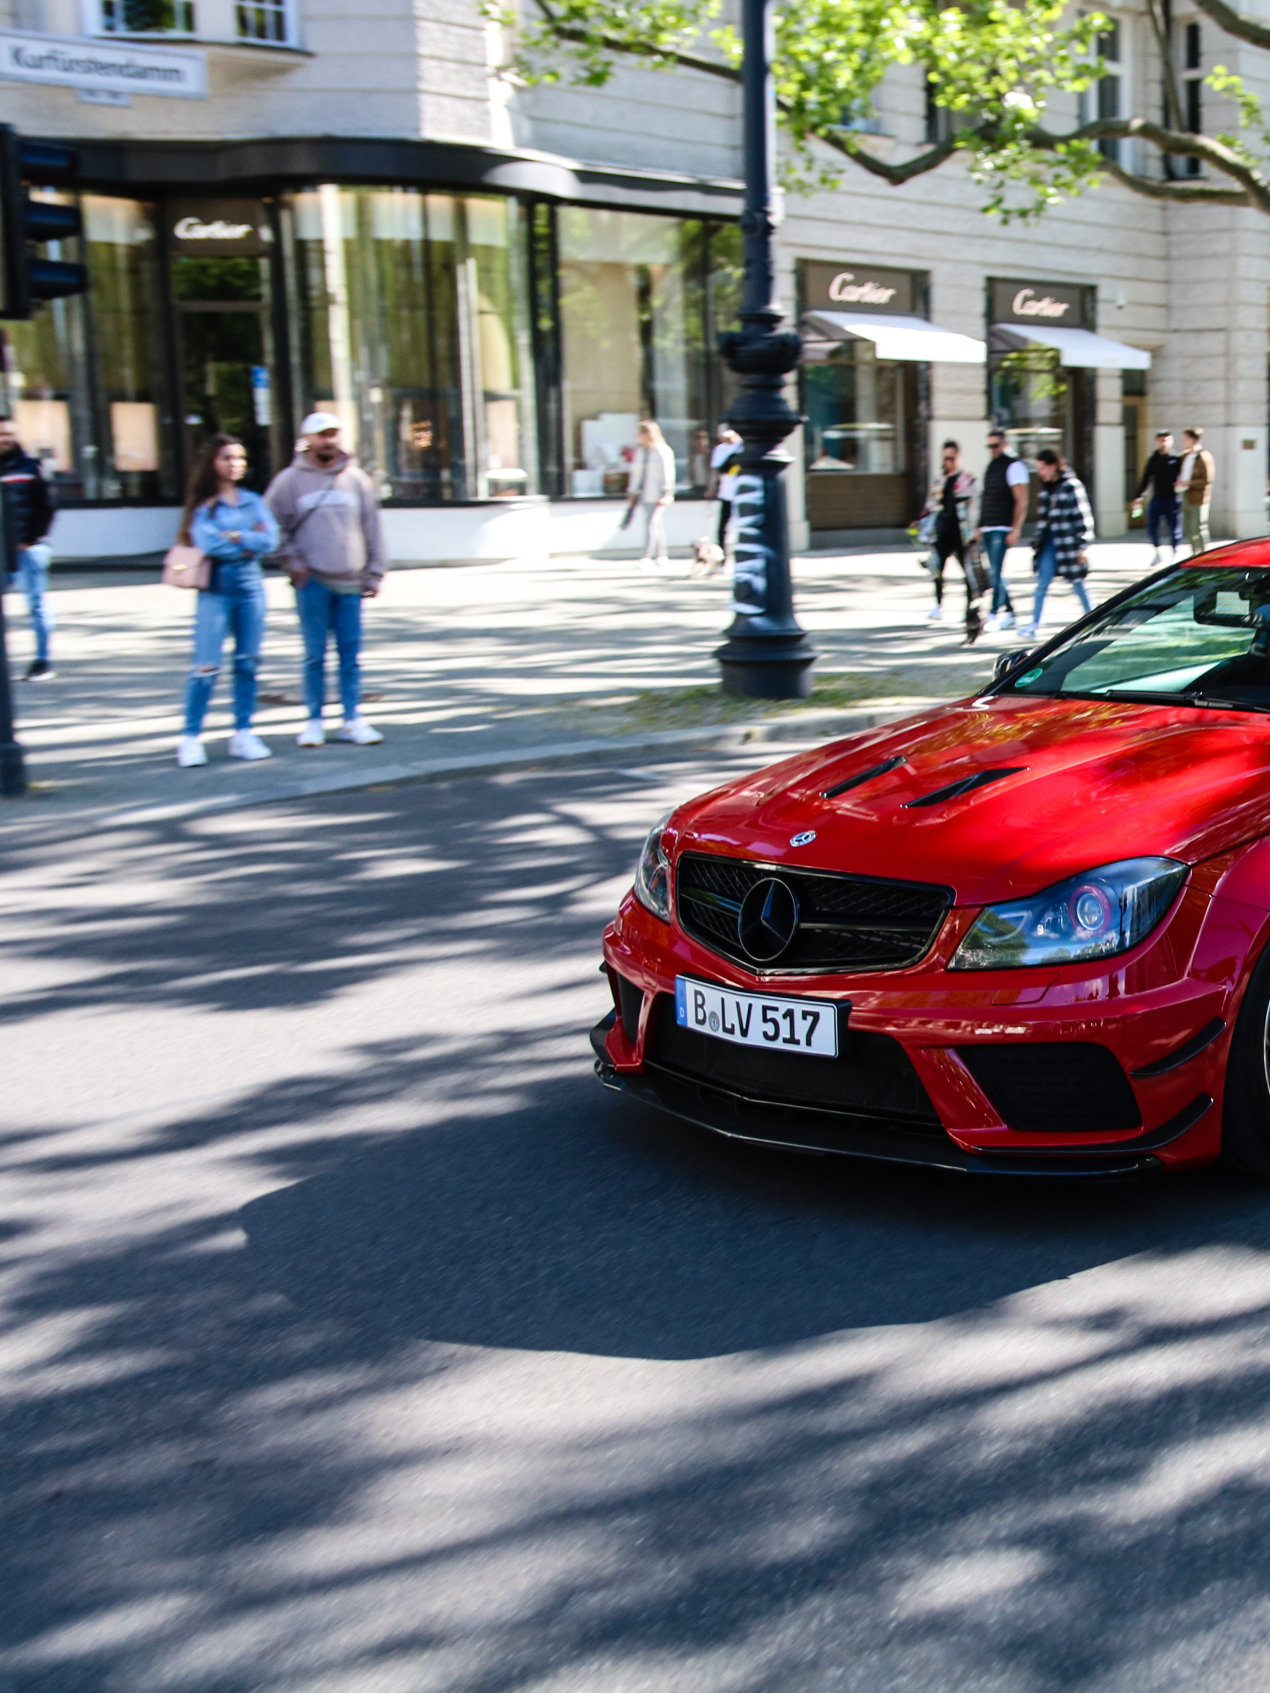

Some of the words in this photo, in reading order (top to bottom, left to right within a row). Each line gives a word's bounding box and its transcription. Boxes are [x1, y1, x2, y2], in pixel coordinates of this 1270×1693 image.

[9, 46, 184, 82] Kurfürstendamm
[174, 216, 253, 239] Cartier
[828, 272, 897, 304] Cartier
[1012, 288, 1070, 317] Cartier
[679, 1006, 685, 1018] D
[693, 988, 707, 1026] B
[721, 996, 753, 1038] LV
[761, 1004, 820, 1047] 517
